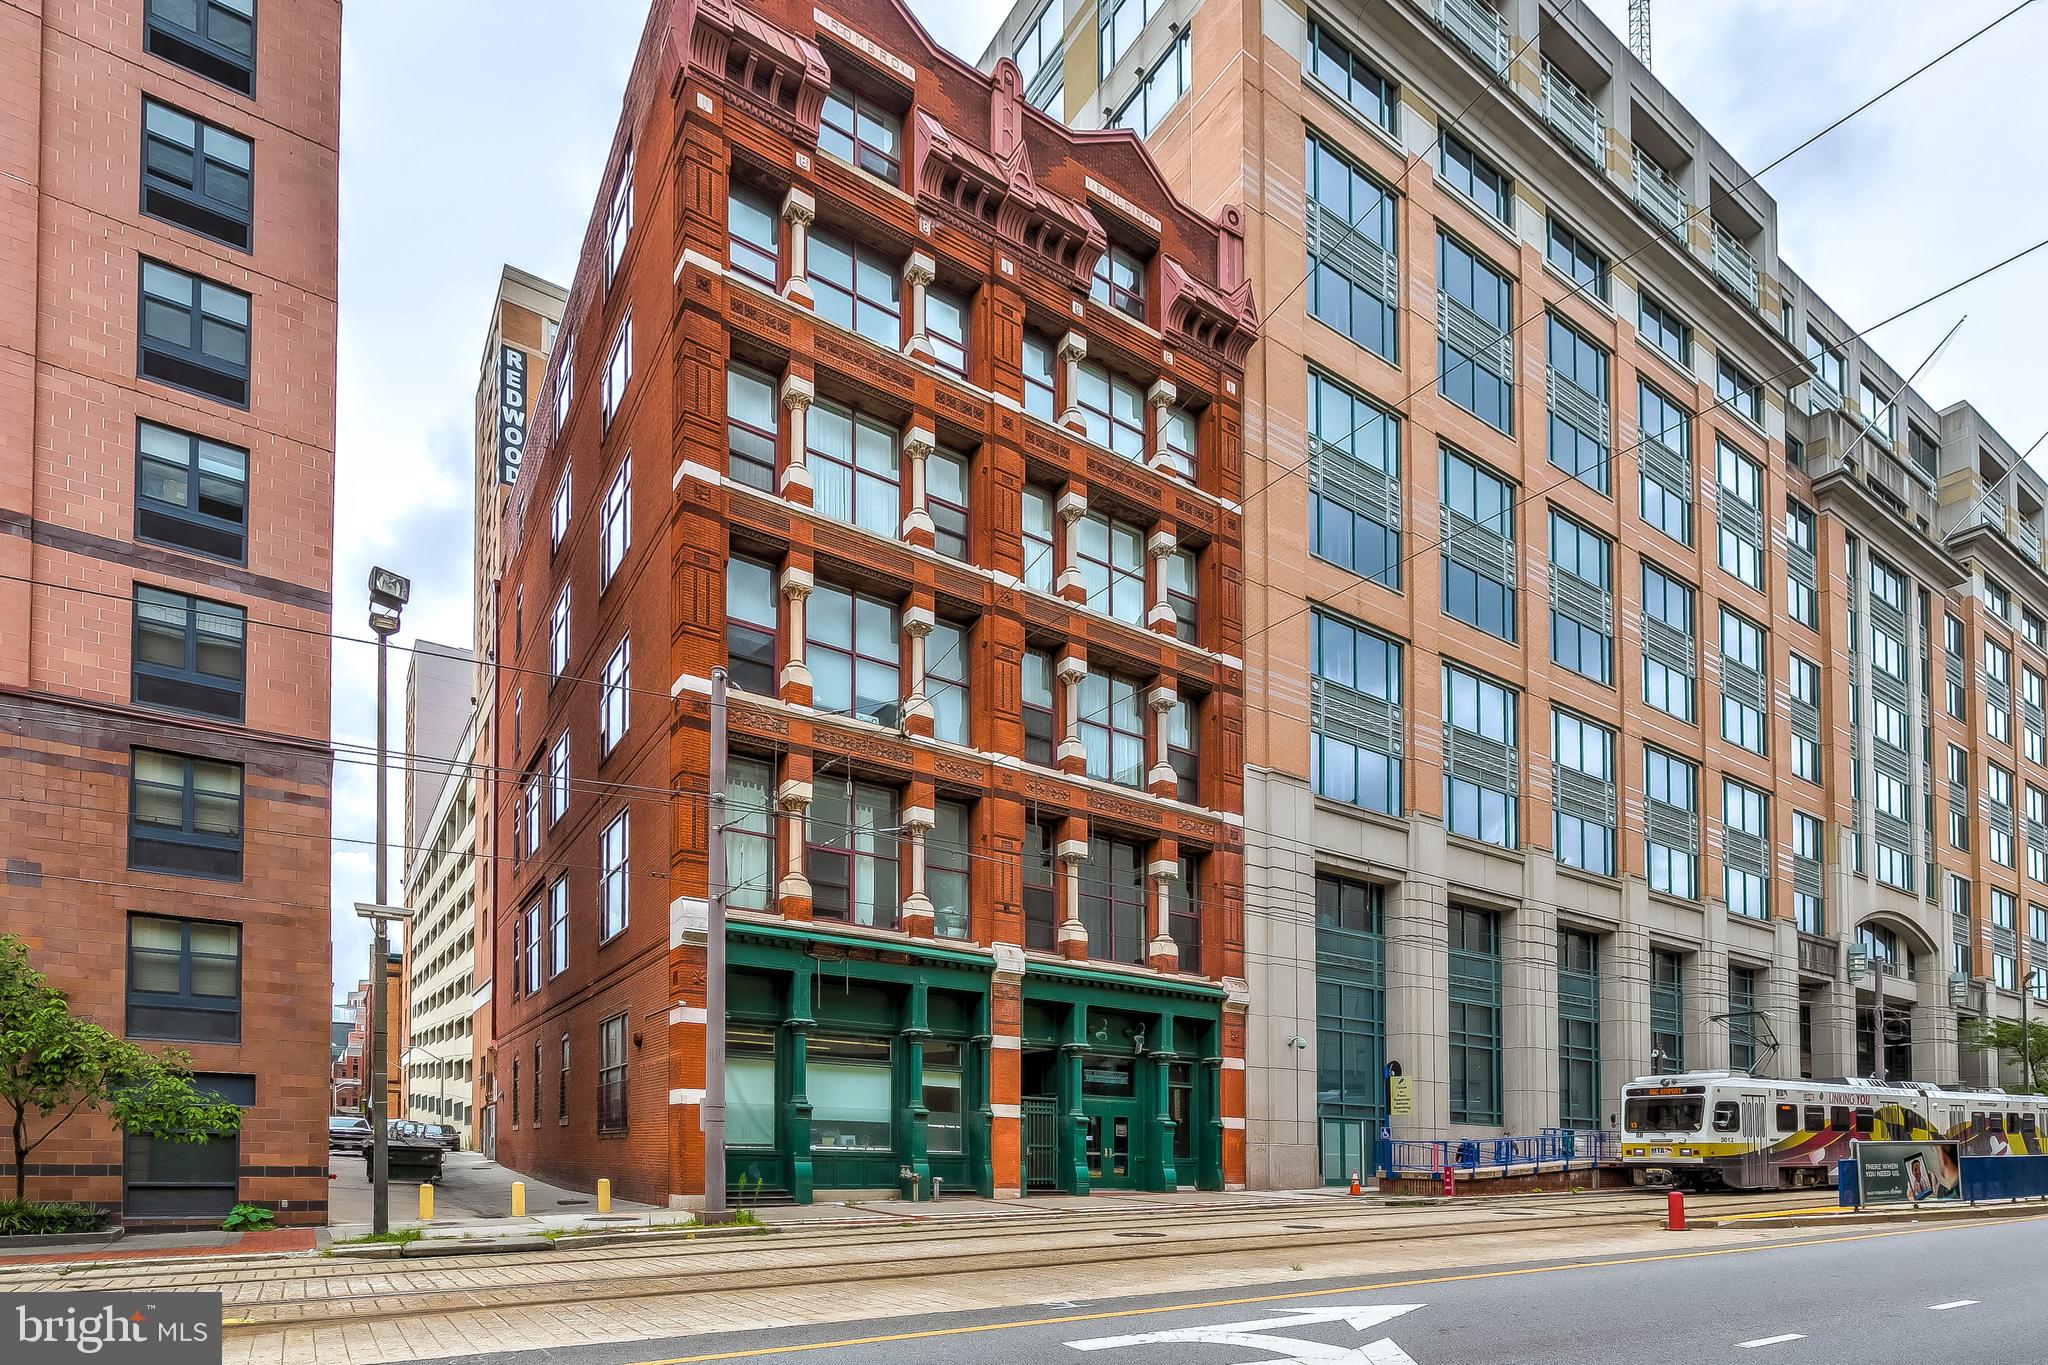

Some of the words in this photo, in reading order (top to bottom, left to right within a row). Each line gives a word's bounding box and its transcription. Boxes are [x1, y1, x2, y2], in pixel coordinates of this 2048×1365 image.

[830, 19, 900, 70] ROMBRO
[1096, 183, 1151, 223] BUILDING
[502, 349, 525, 484] REDWOOD
[1829, 1092, 1855, 1104] LINKING
[1856, 1094, 1871, 1106] YOU
[1865, 1170, 1876, 1178] YOU
